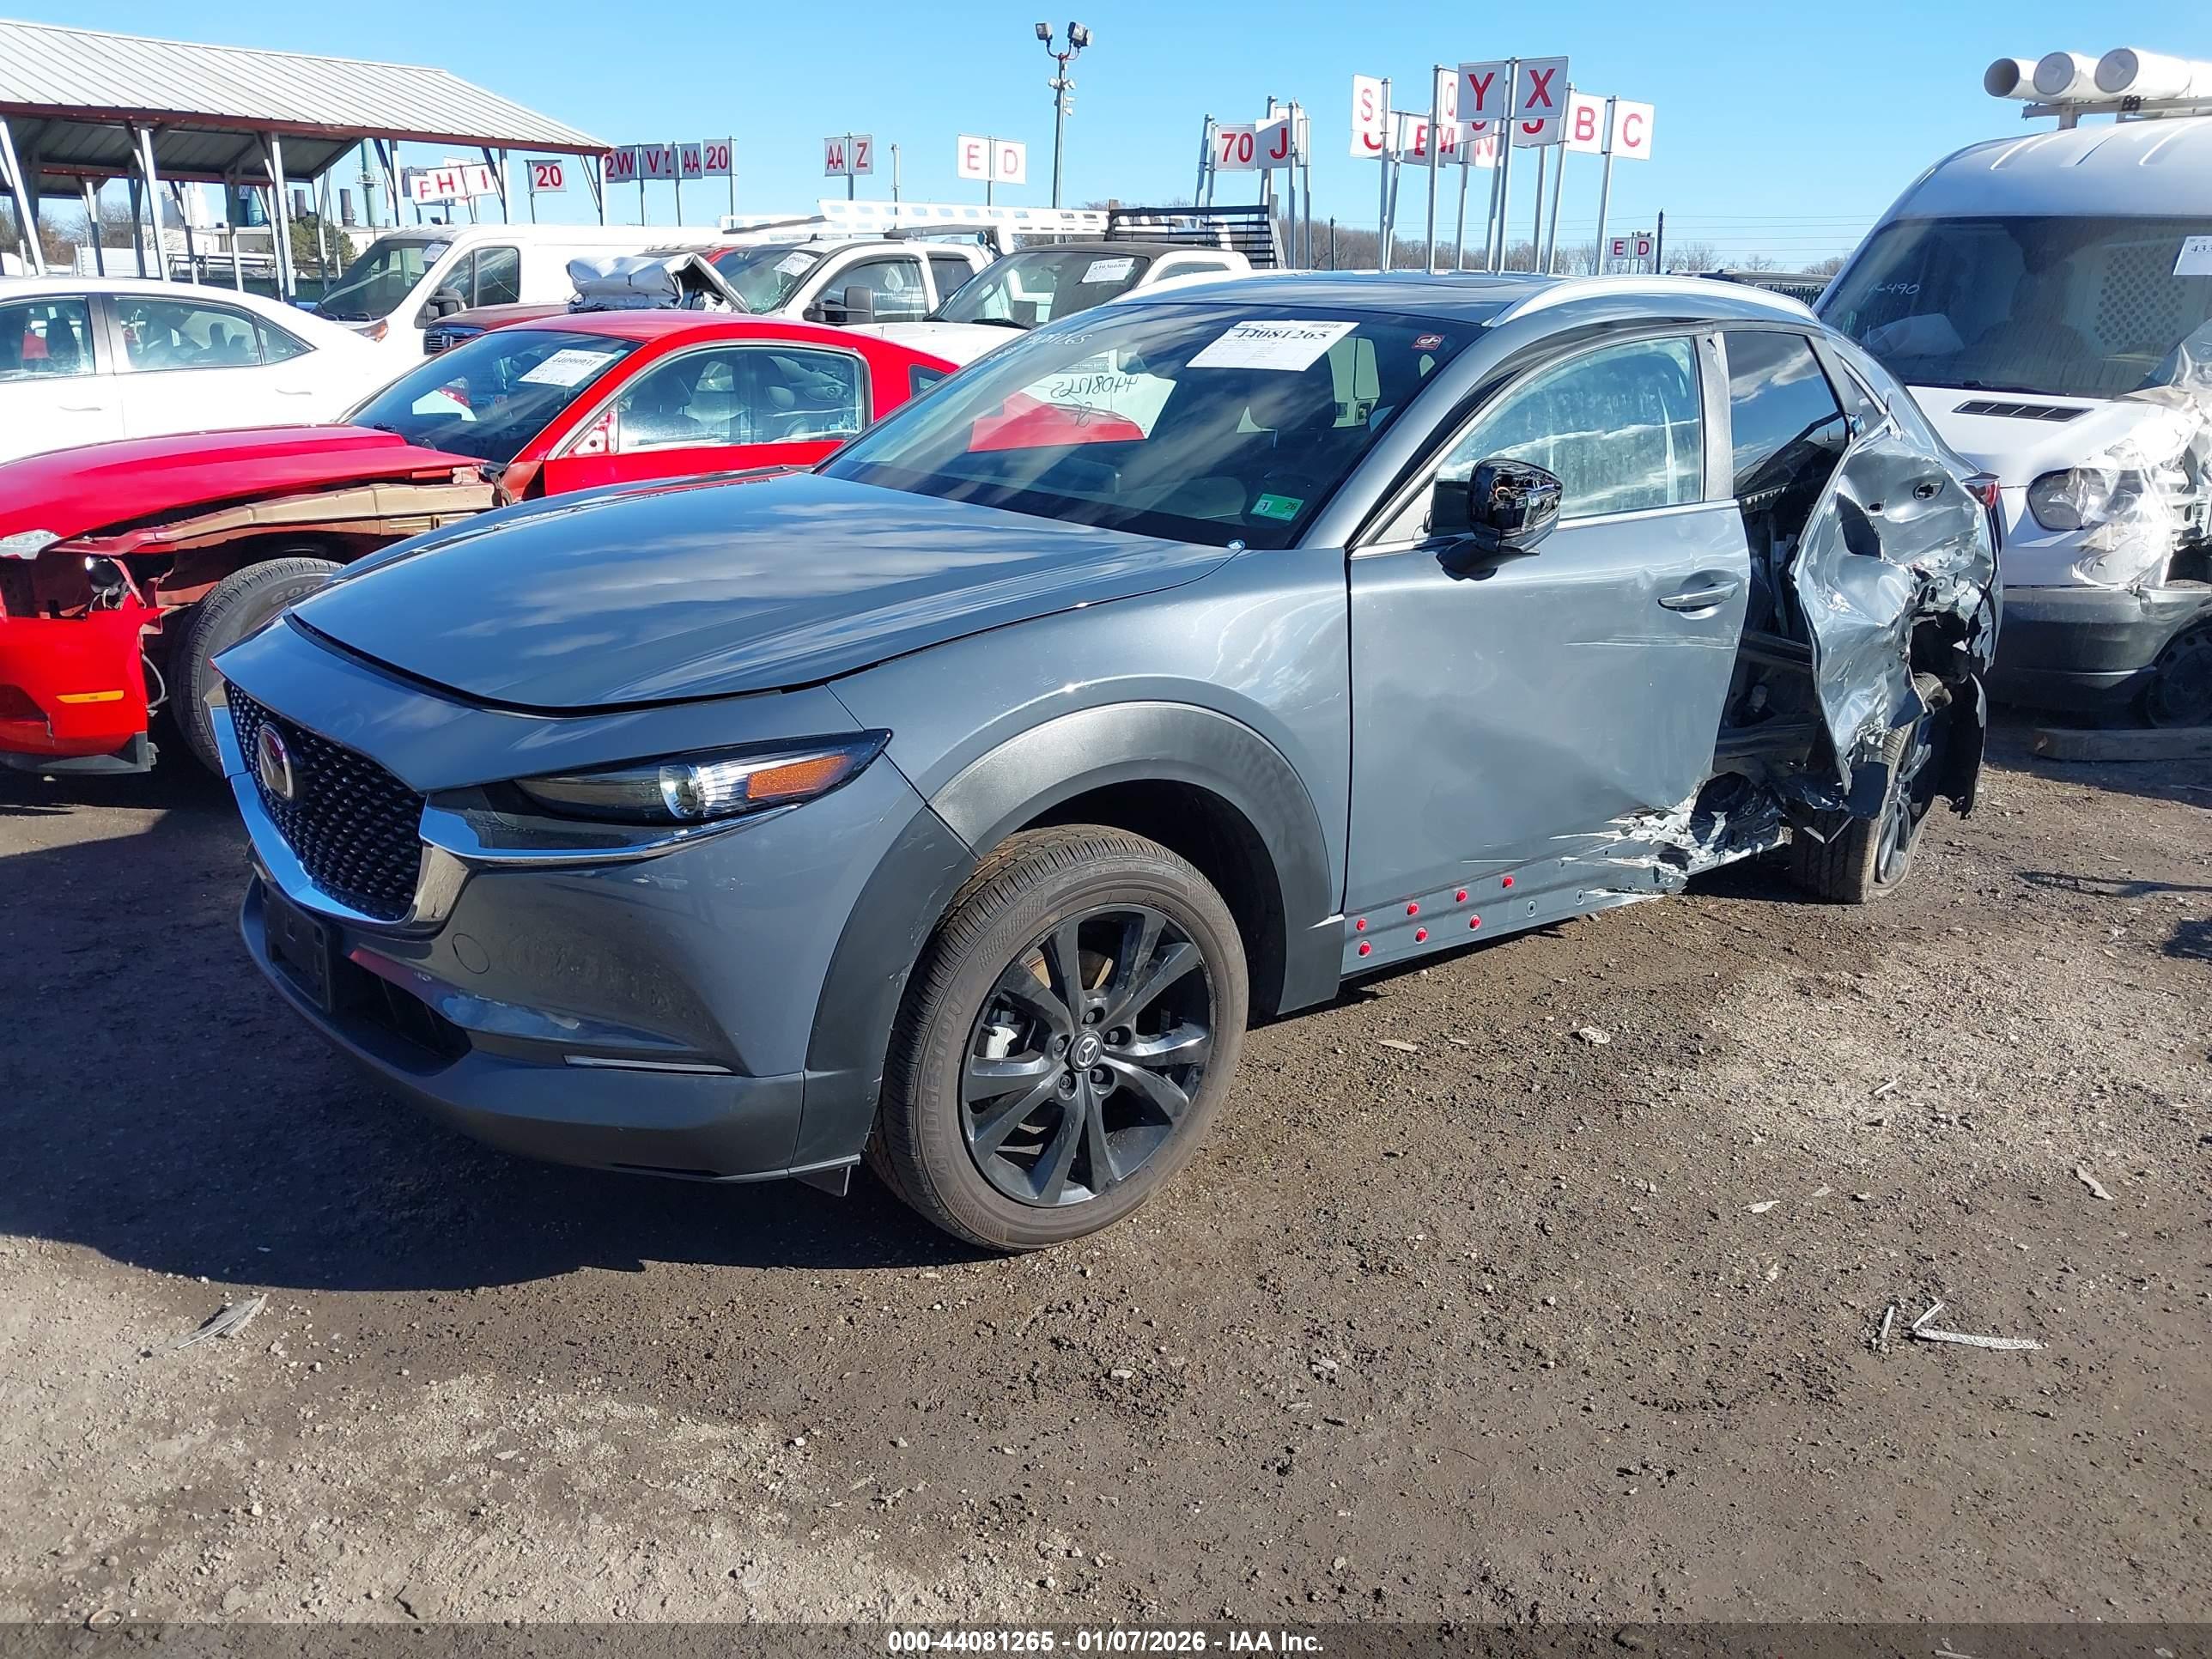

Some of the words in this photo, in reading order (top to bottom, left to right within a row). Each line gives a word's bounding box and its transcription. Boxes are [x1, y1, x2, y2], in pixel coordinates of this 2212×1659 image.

[1468, 72, 1495, 111] Y
[1525, 68, 1556, 108] X
[1360, 88, 1373, 122] S
[1575, 106, 1595, 141] B
[1623, 113, 1644, 147] C
[826, 143, 844, 170] AA
[856, 142, 868, 168] Z
[967, 143, 980, 170] E
[1221, 132, 1254, 163] 70
[1269, 127, 1287, 160] J
[616, 152, 634, 174] W
[646, 150, 659, 173] V
[684, 150, 701, 173] AA
[706, 145, 728, 169] 20
[1004, 149, 1018, 174] D
[435, 173, 456, 193] H
[535, 165, 562, 187] 20
[1613, 240, 1625, 256] E
[1638, 240, 1650, 256] D
